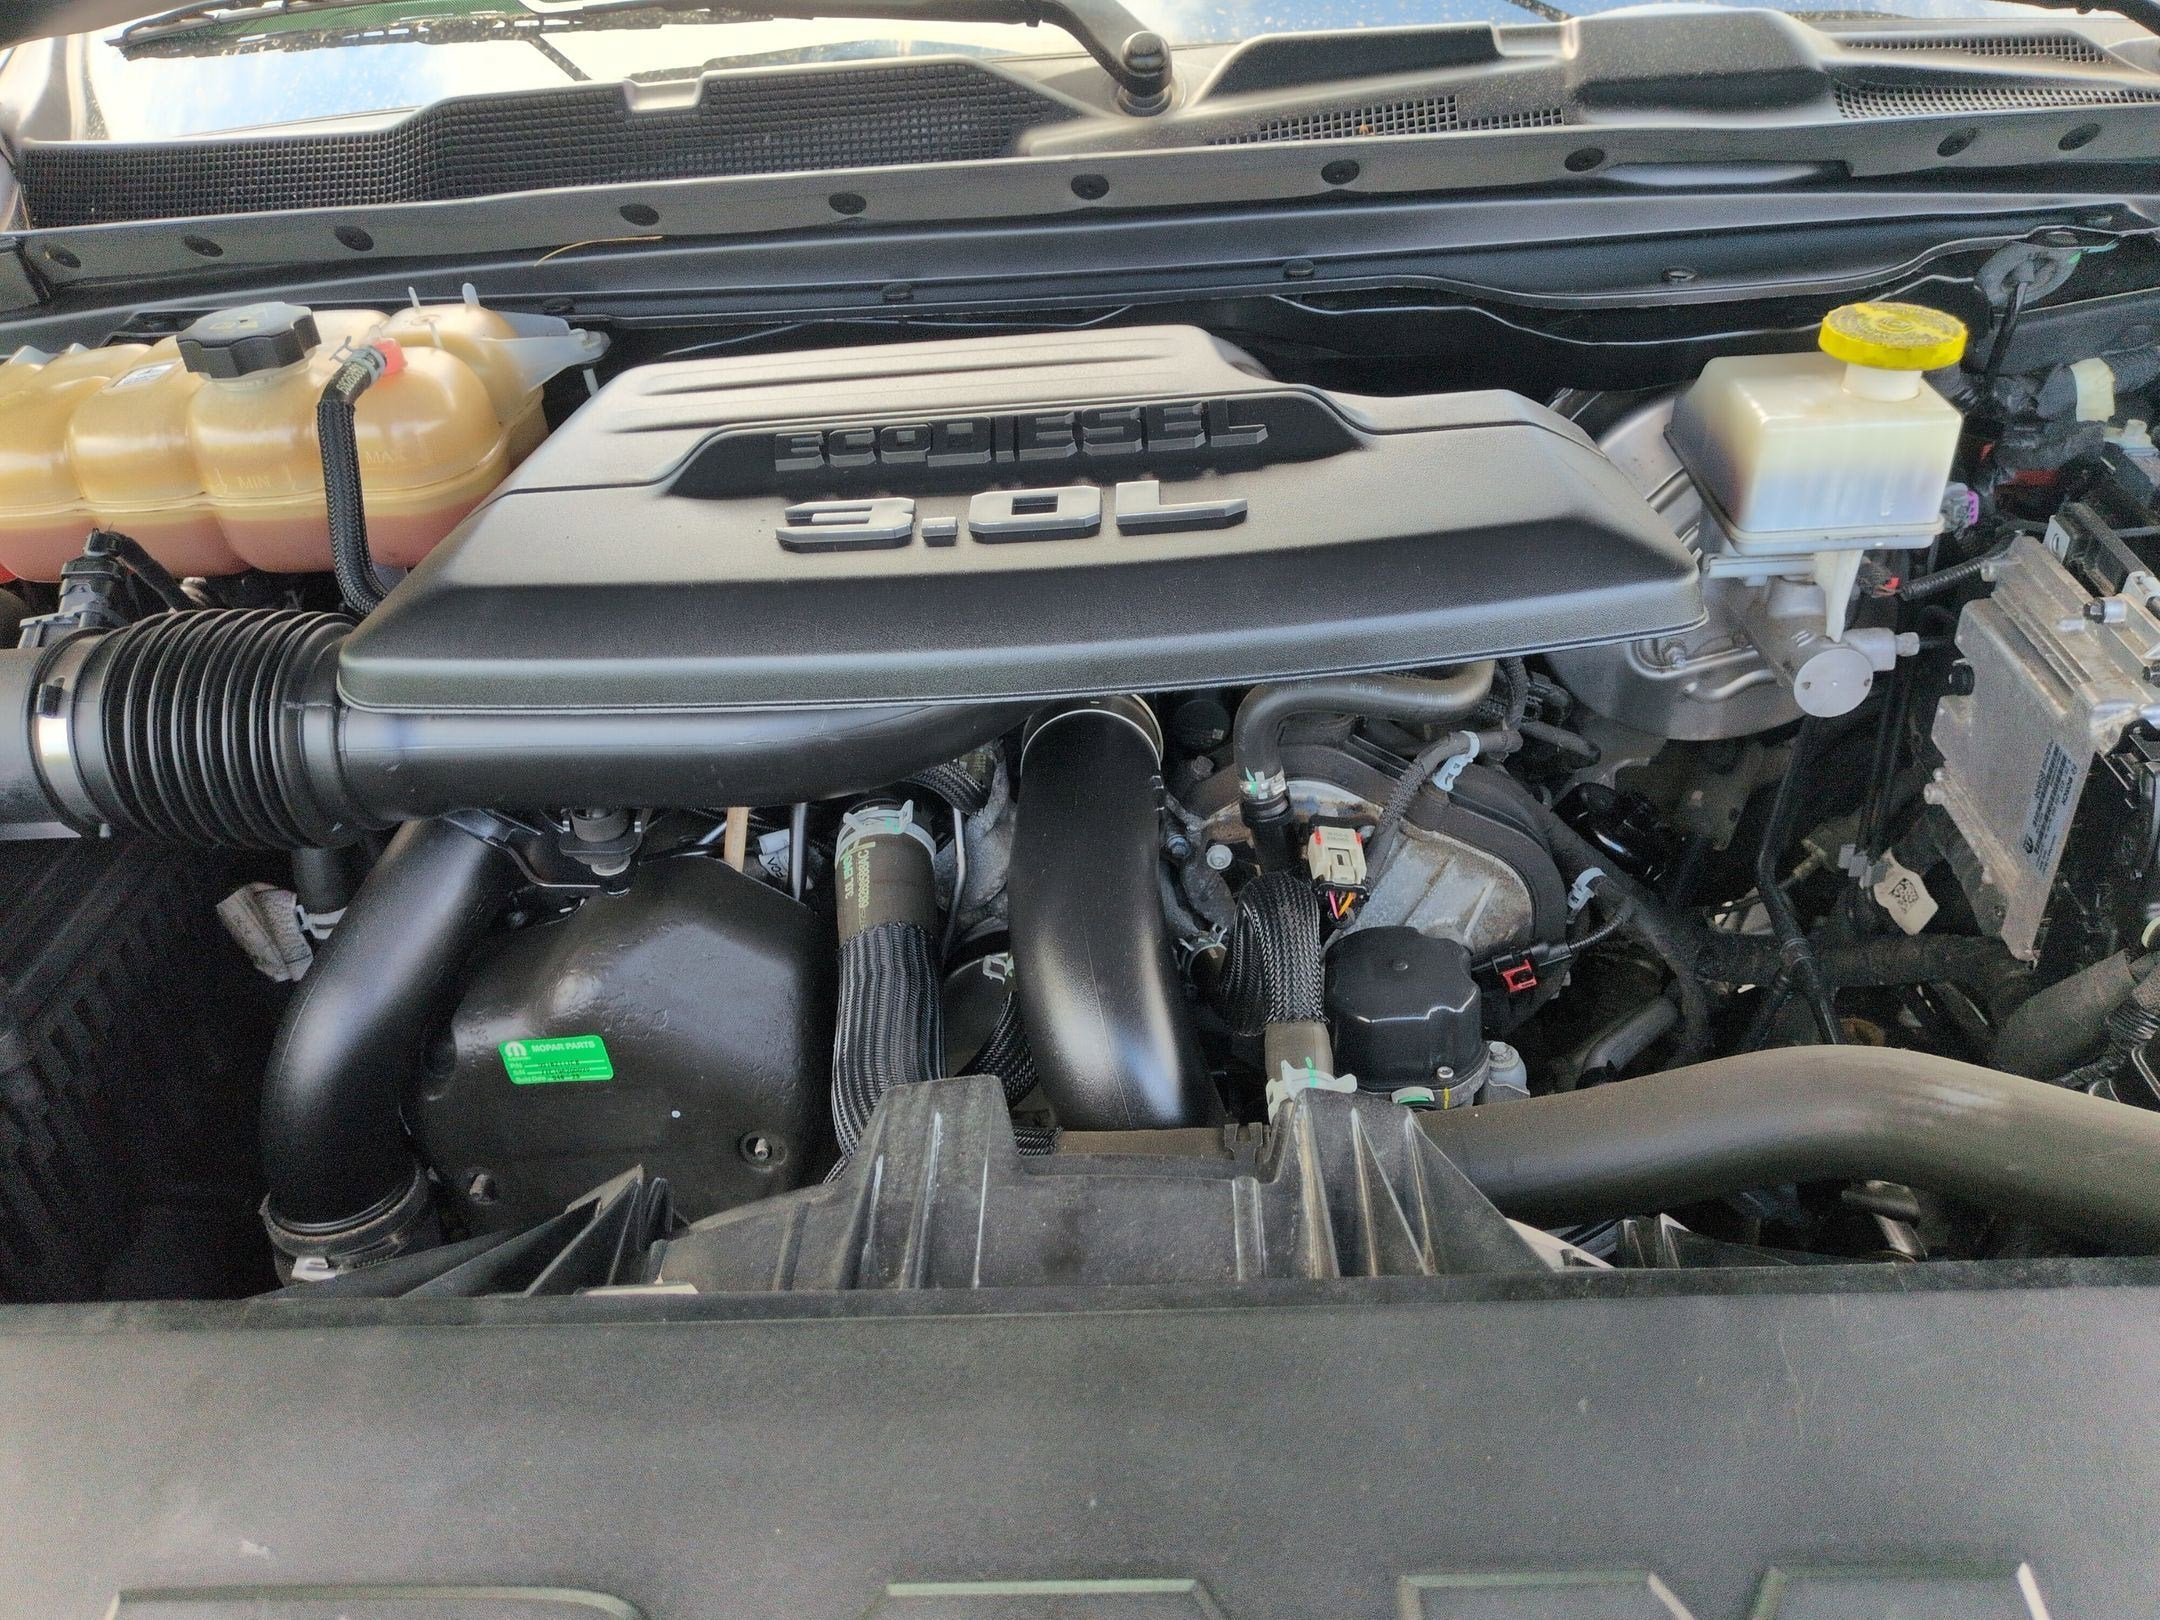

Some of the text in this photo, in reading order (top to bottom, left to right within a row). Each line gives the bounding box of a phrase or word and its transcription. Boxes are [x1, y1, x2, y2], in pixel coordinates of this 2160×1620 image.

[775, 398, 1268, 471] ECODIESEL
[775, 480, 1248, 551] 3.0L
[532, 1041, 596, 1053] MOPAR PARTS
